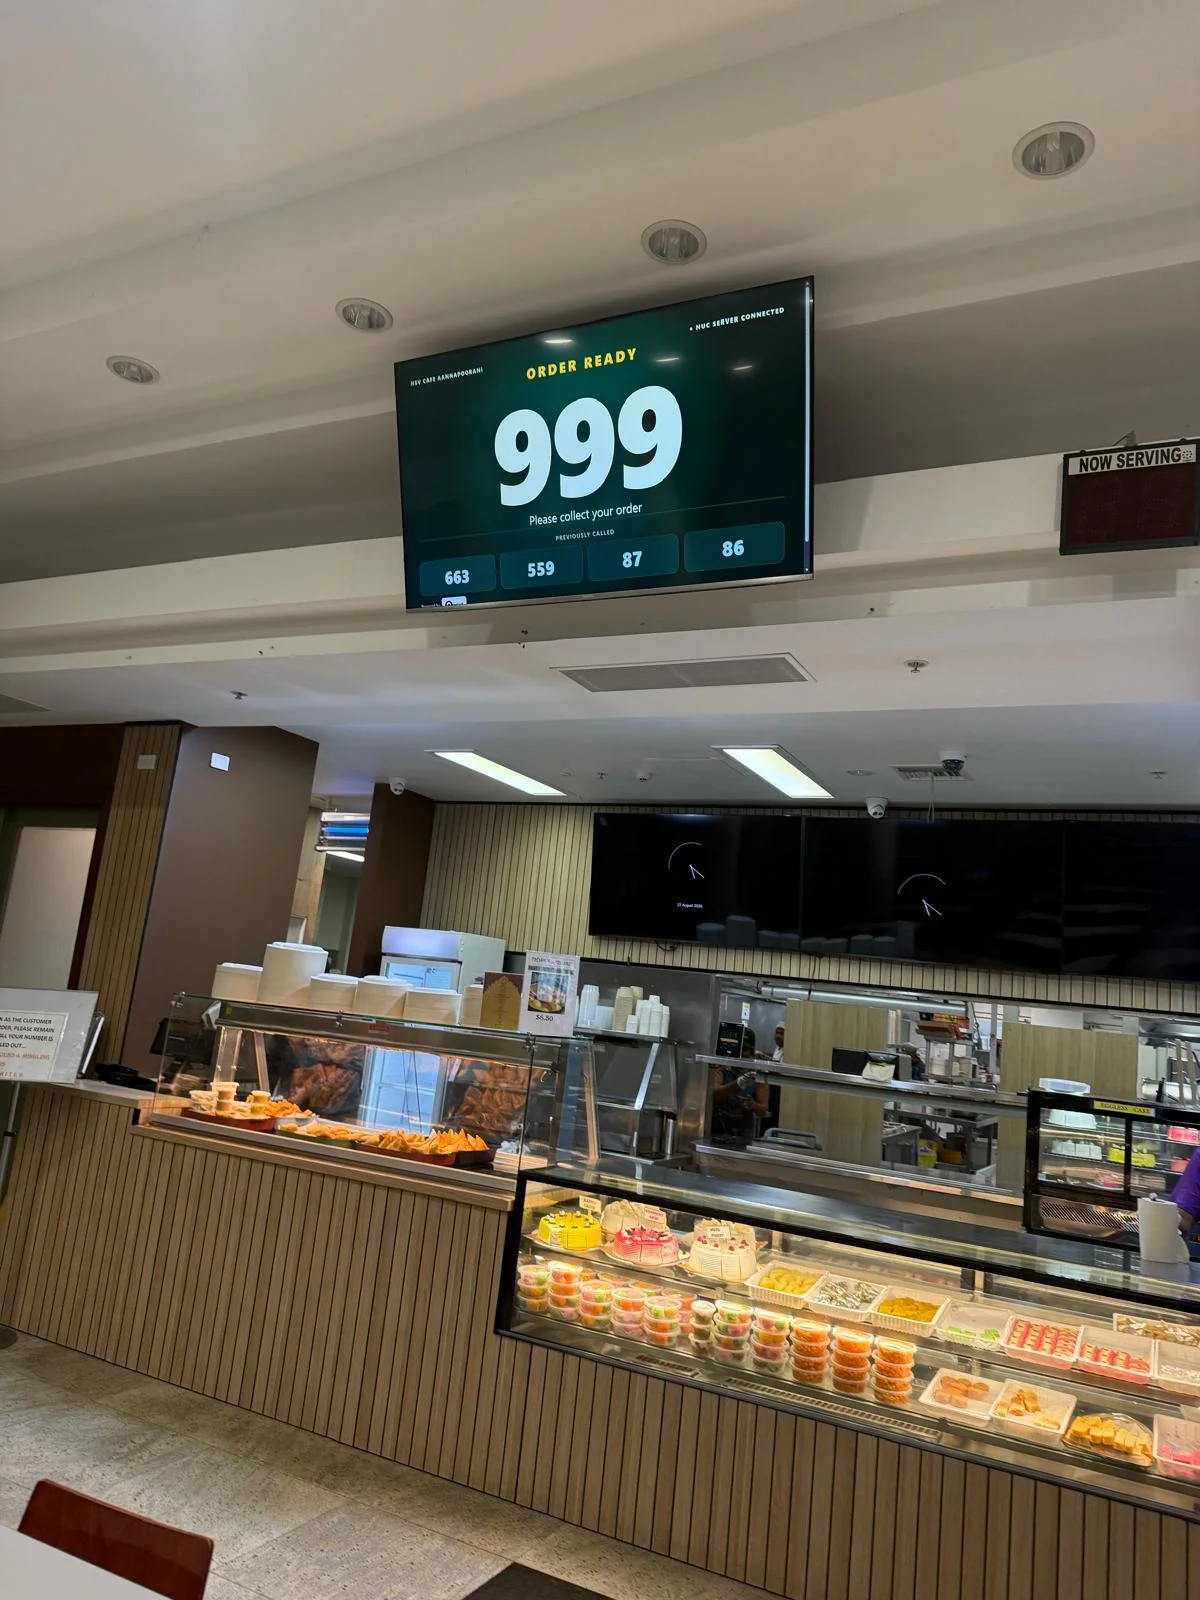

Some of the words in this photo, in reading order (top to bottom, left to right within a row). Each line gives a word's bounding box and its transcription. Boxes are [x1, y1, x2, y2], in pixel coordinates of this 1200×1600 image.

[696, 322, 710, 330] NUC
[712, 316, 739, 327] SERVER
[741, 307, 784, 321] CONNECTED
[526, 360, 576, 379] ORDER
[584, 348, 636, 369] READY
[494, 385, 682, 506] 999
[1079, 455, 1112, 473] NOW
[1116, 447, 1181, 469] SERVING
[529, 515, 557, 526] Please
[560, 510, 589, 522] collect
[592, 508, 613, 521] your
[616, 502, 642, 515] order
[556, 531, 590, 541] PREVIOUSLY
[592, 529, 615, 537] CALLED
[722, 540, 745, 557] 86
[528, 561, 555, 578] 559
[622, 551, 642, 568] 87
[445, 570, 470, 585] 663
